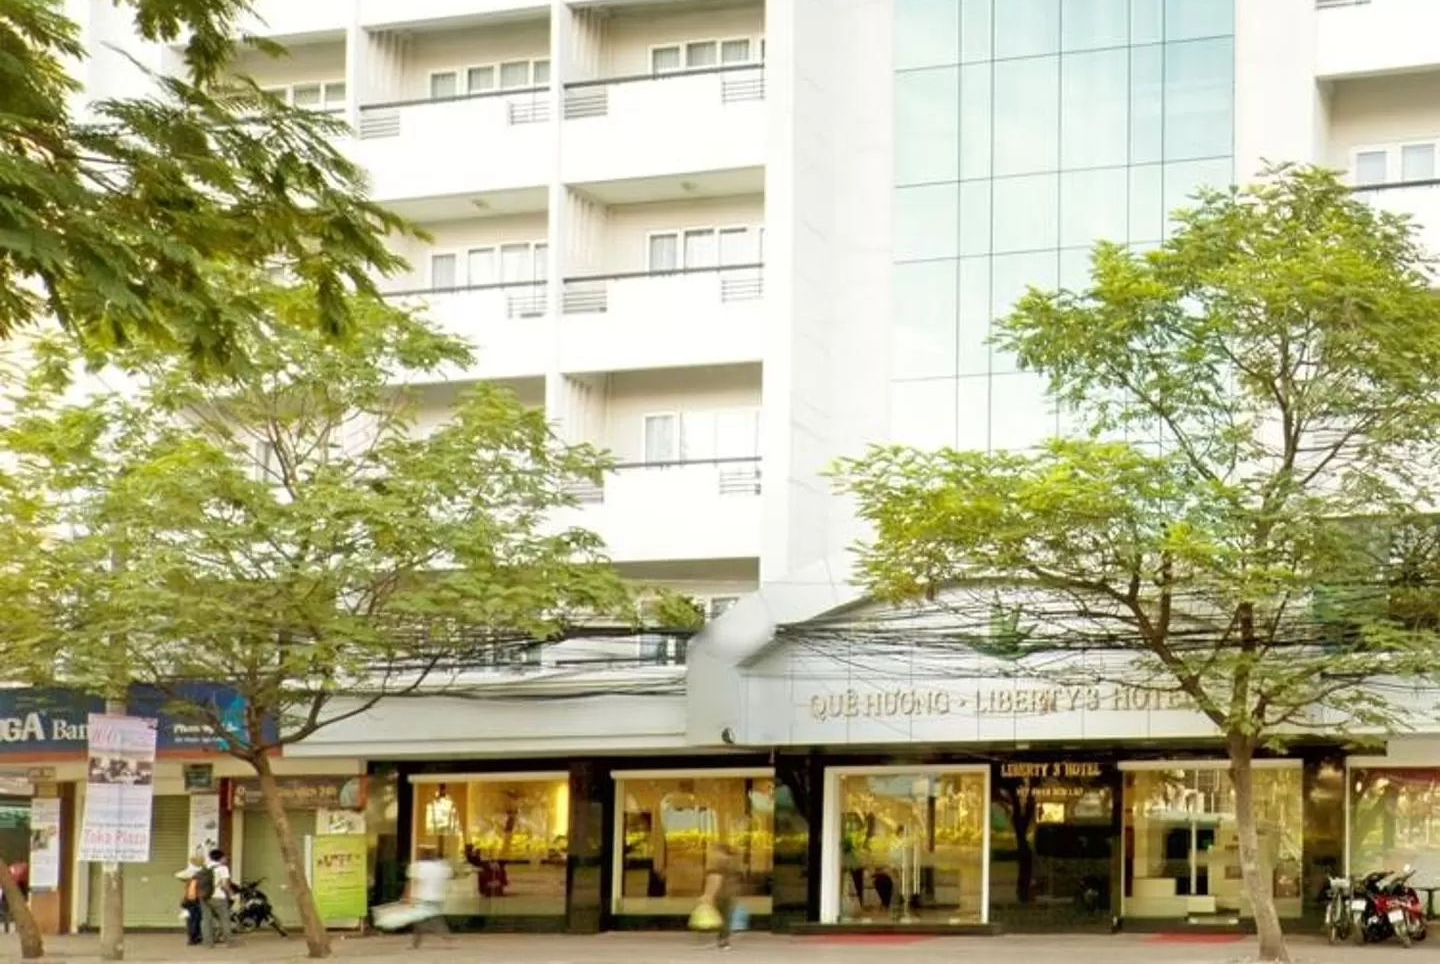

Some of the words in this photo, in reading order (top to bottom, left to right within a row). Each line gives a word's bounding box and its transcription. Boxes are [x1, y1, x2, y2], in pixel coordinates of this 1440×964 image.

[811, 688, 859, 722] QUÊ
[975, 686, 1082, 714] LIBERTY
[0, 711, 45, 742] GA
[52, 718, 88, 741] Ban
